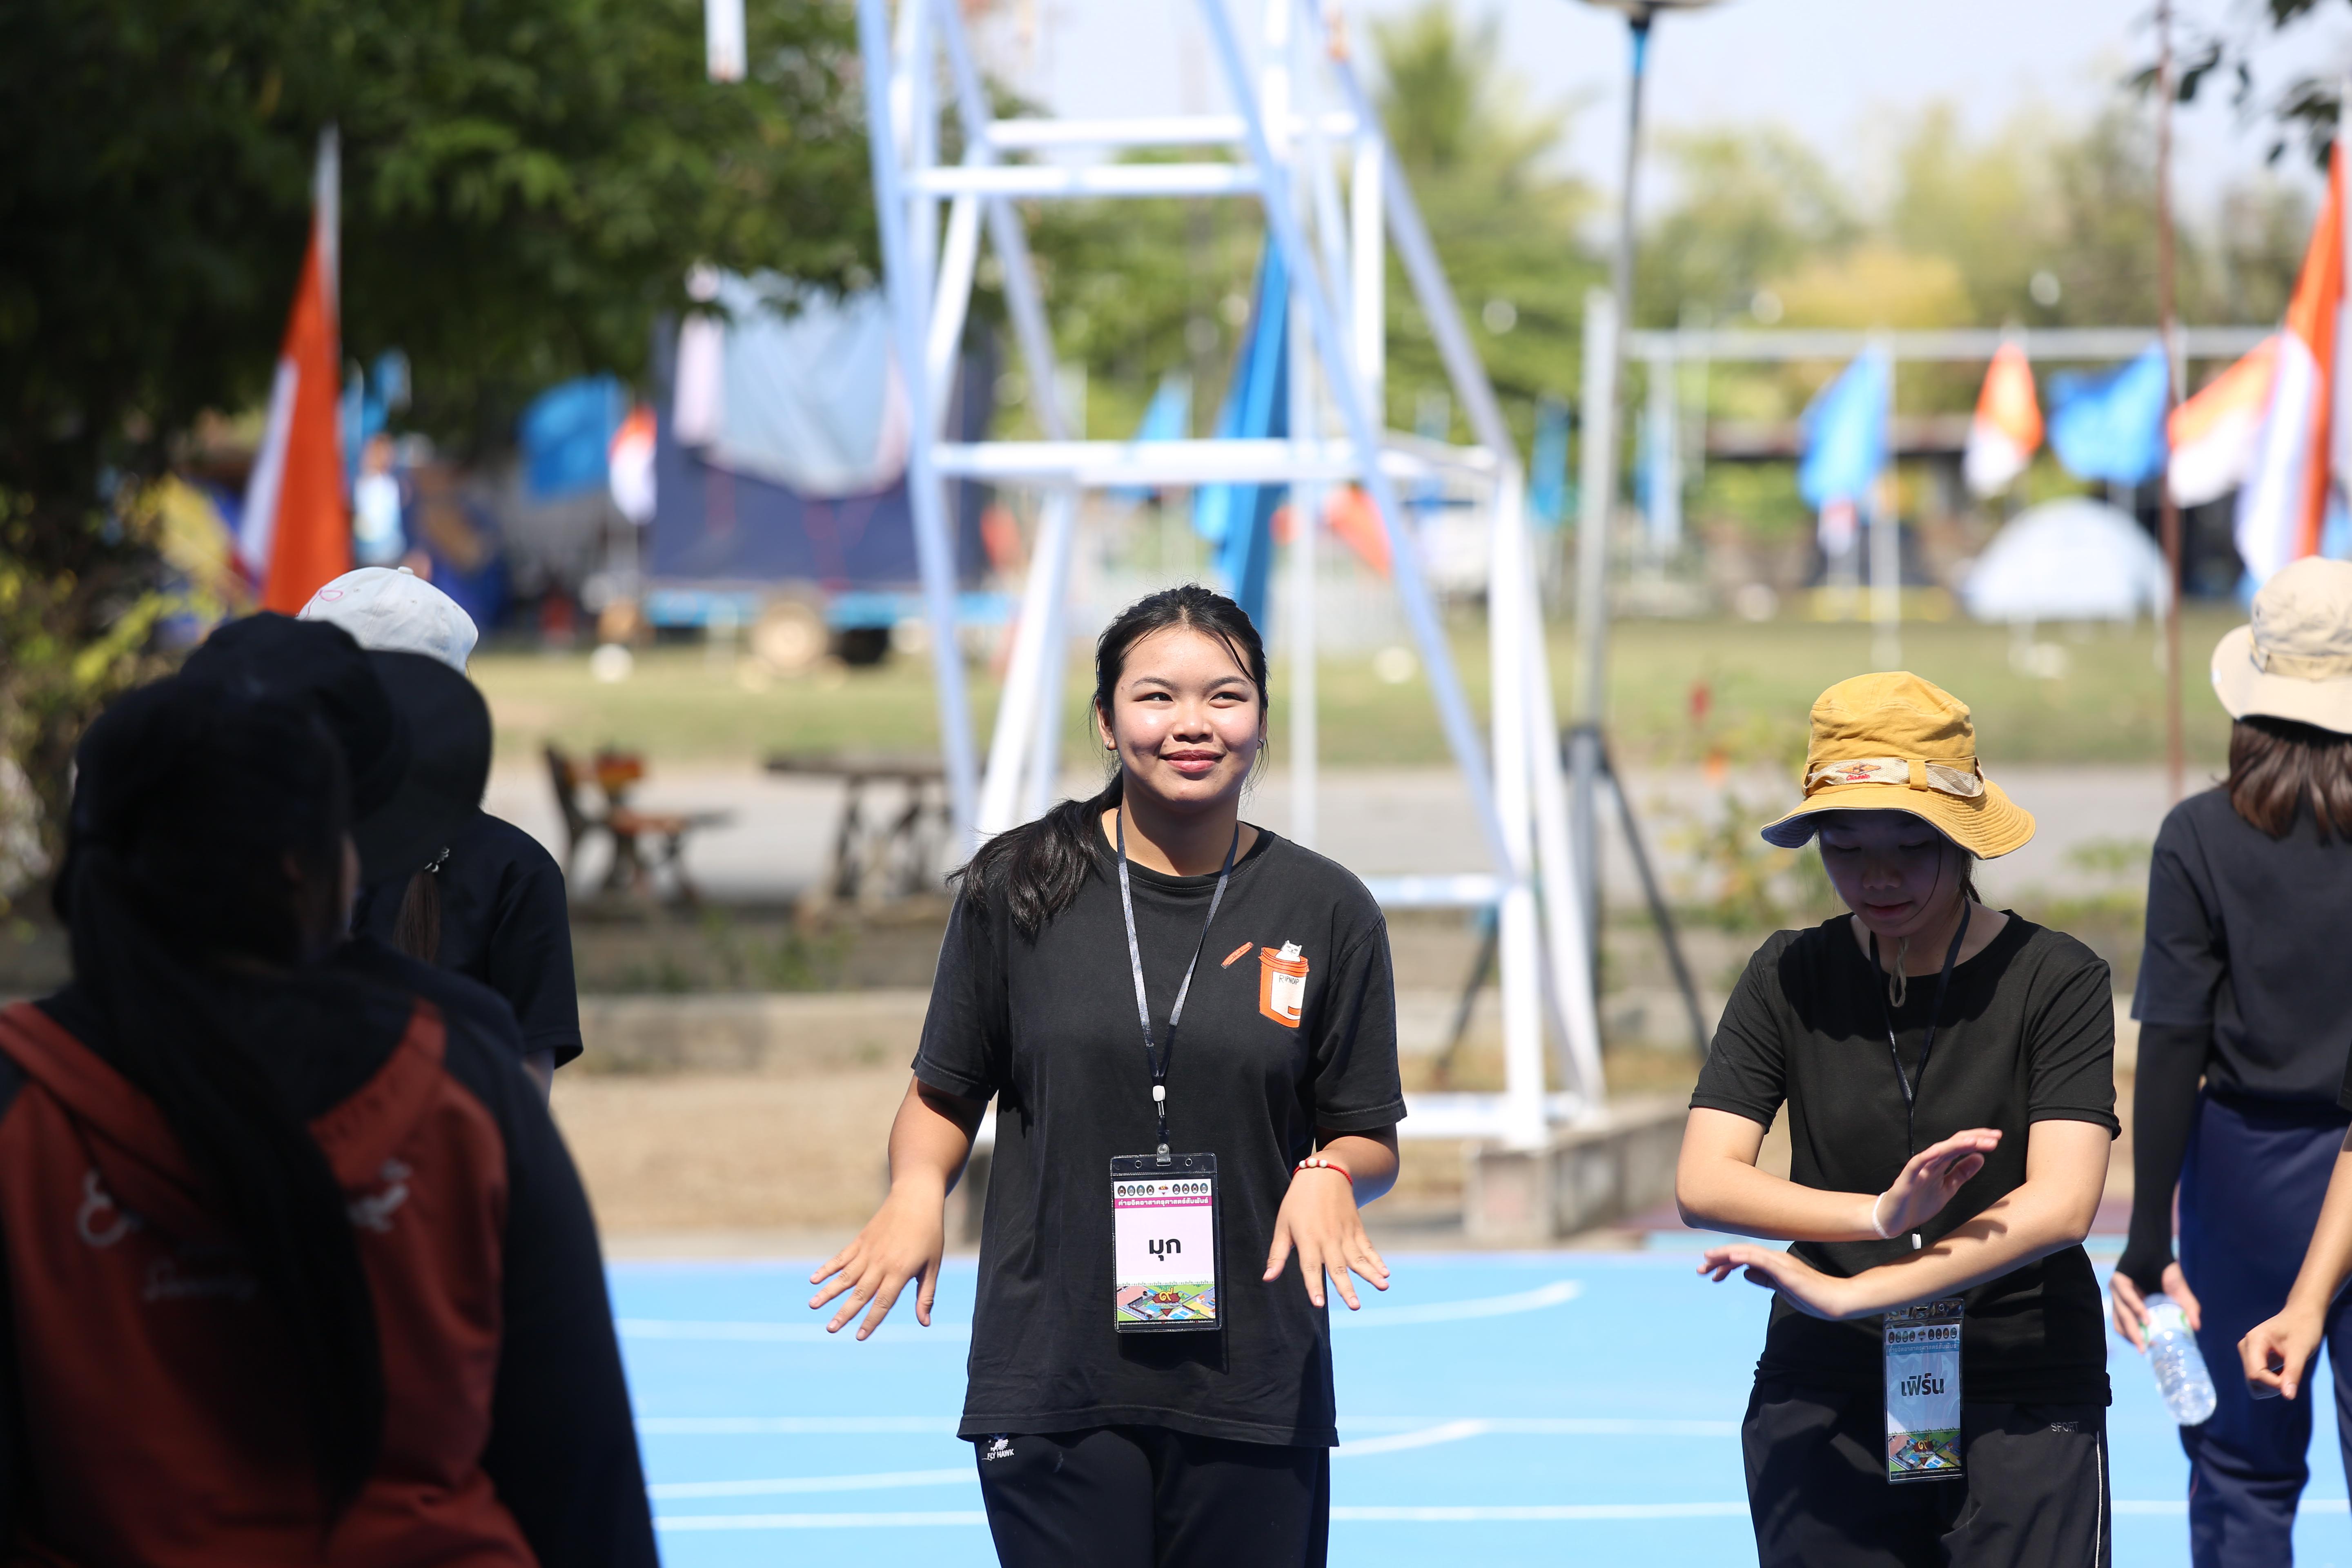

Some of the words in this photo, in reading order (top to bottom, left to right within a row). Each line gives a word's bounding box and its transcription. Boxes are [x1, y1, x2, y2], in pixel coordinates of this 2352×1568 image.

[1279, 975, 1299, 985] RIPNDIP
[1149, 1238, 1181, 1261] มุก
[1901, 1373, 1944, 1396] เฟิร์น
[2051, 1421, 2078, 1432] SPORT
[997, 1448, 1014, 1458] HAWK
